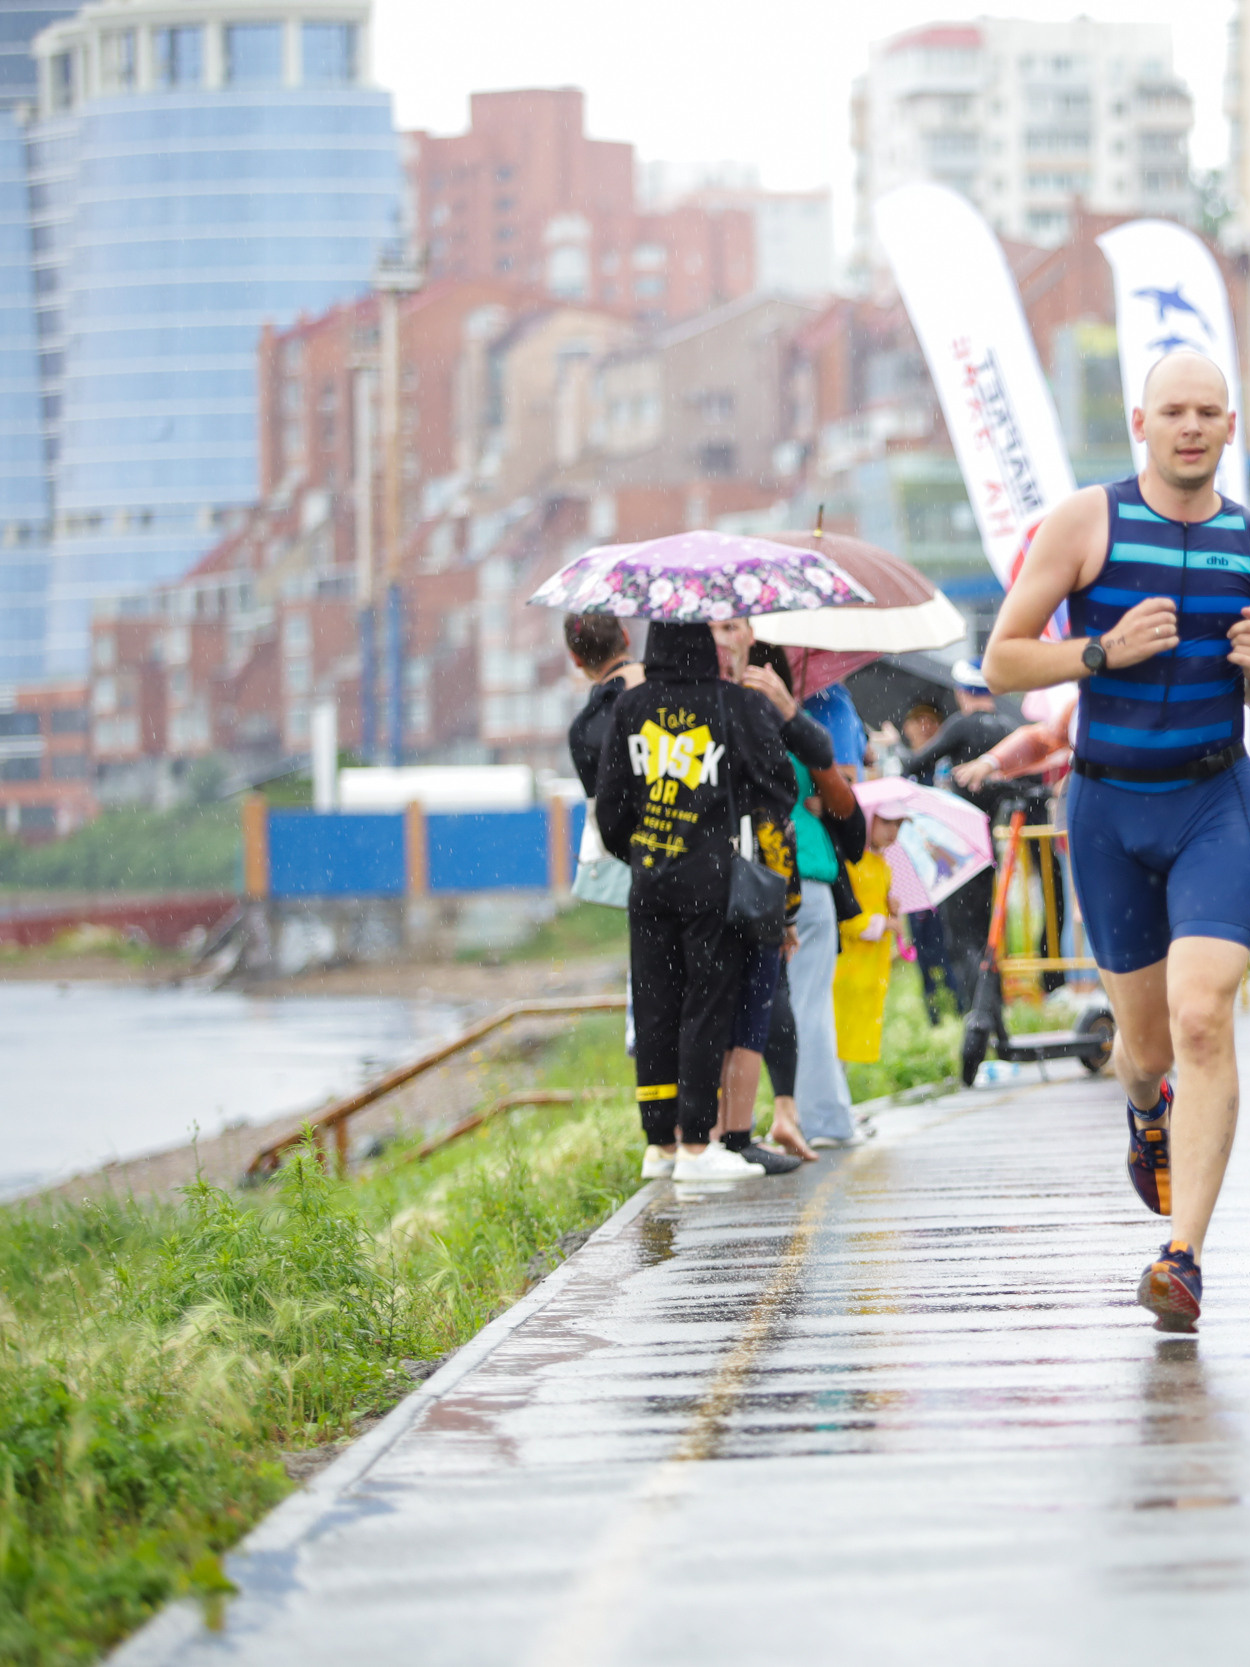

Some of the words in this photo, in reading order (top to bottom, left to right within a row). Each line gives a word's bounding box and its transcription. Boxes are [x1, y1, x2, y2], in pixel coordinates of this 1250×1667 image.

[1206, 555, 1229, 566] dhb
[656, 707, 697, 729] Take
[627, 734, 726, 787] RISK
[649, 779, 679, 805] OR
